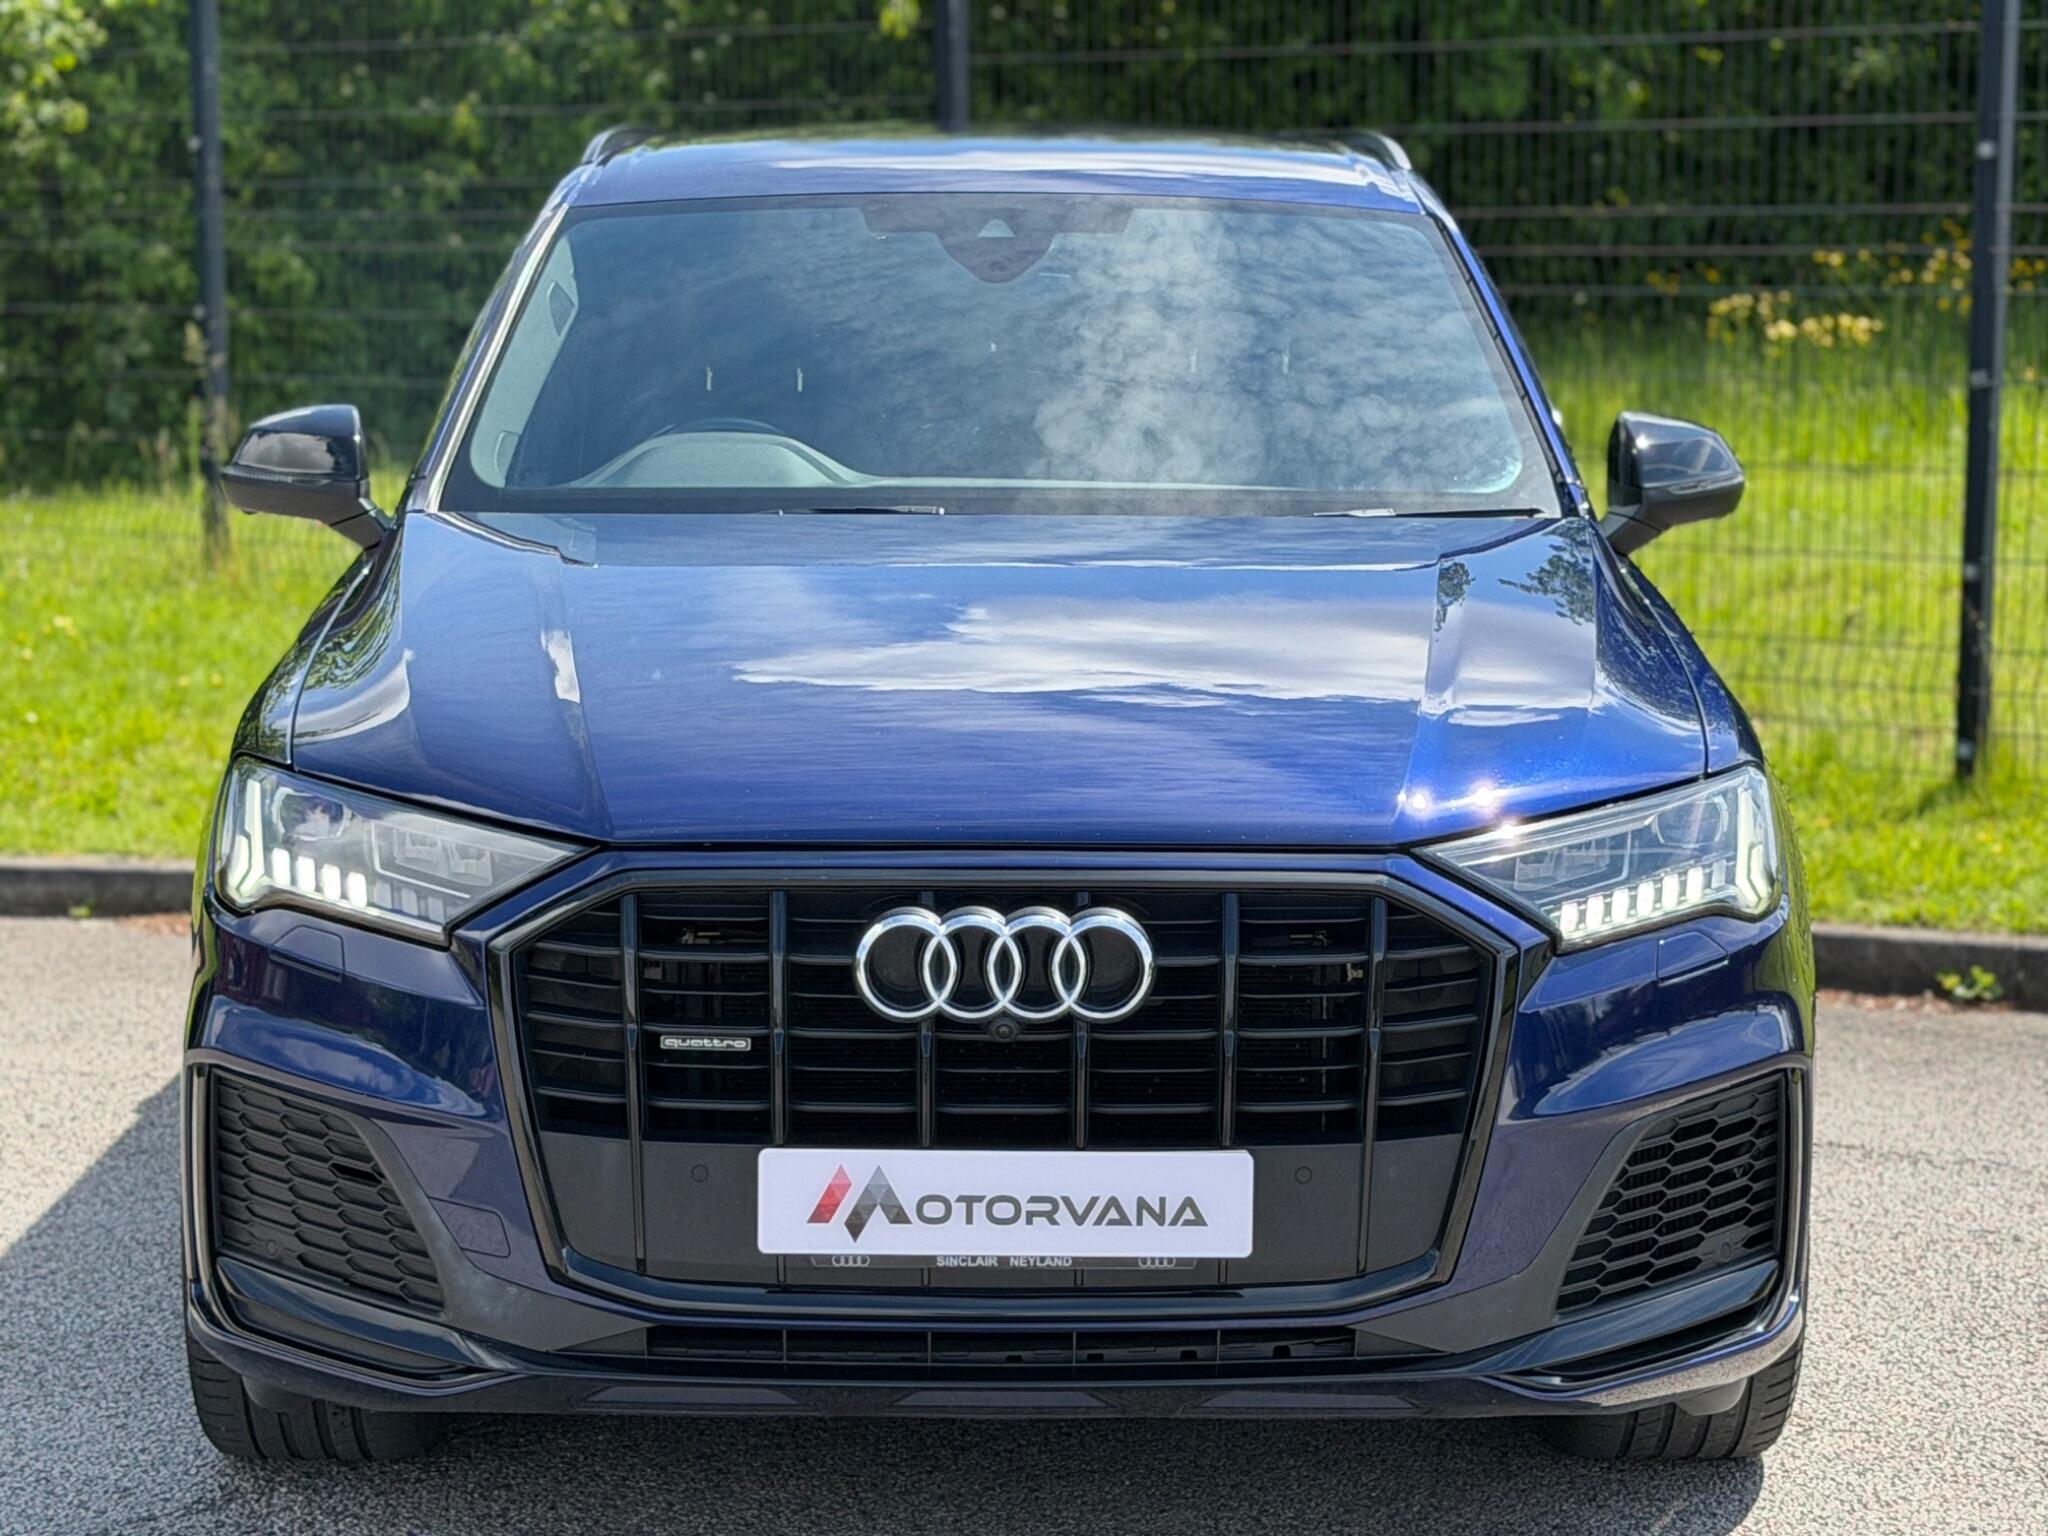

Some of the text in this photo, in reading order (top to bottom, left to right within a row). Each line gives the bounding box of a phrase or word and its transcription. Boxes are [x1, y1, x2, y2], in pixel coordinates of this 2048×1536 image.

[663, 1038, 747, 1049] quattro
[807, 1164, 1209, 1243] MOTORVANA
[936, 1255, 1073, 1267] SINCLAIR NEYLAND
